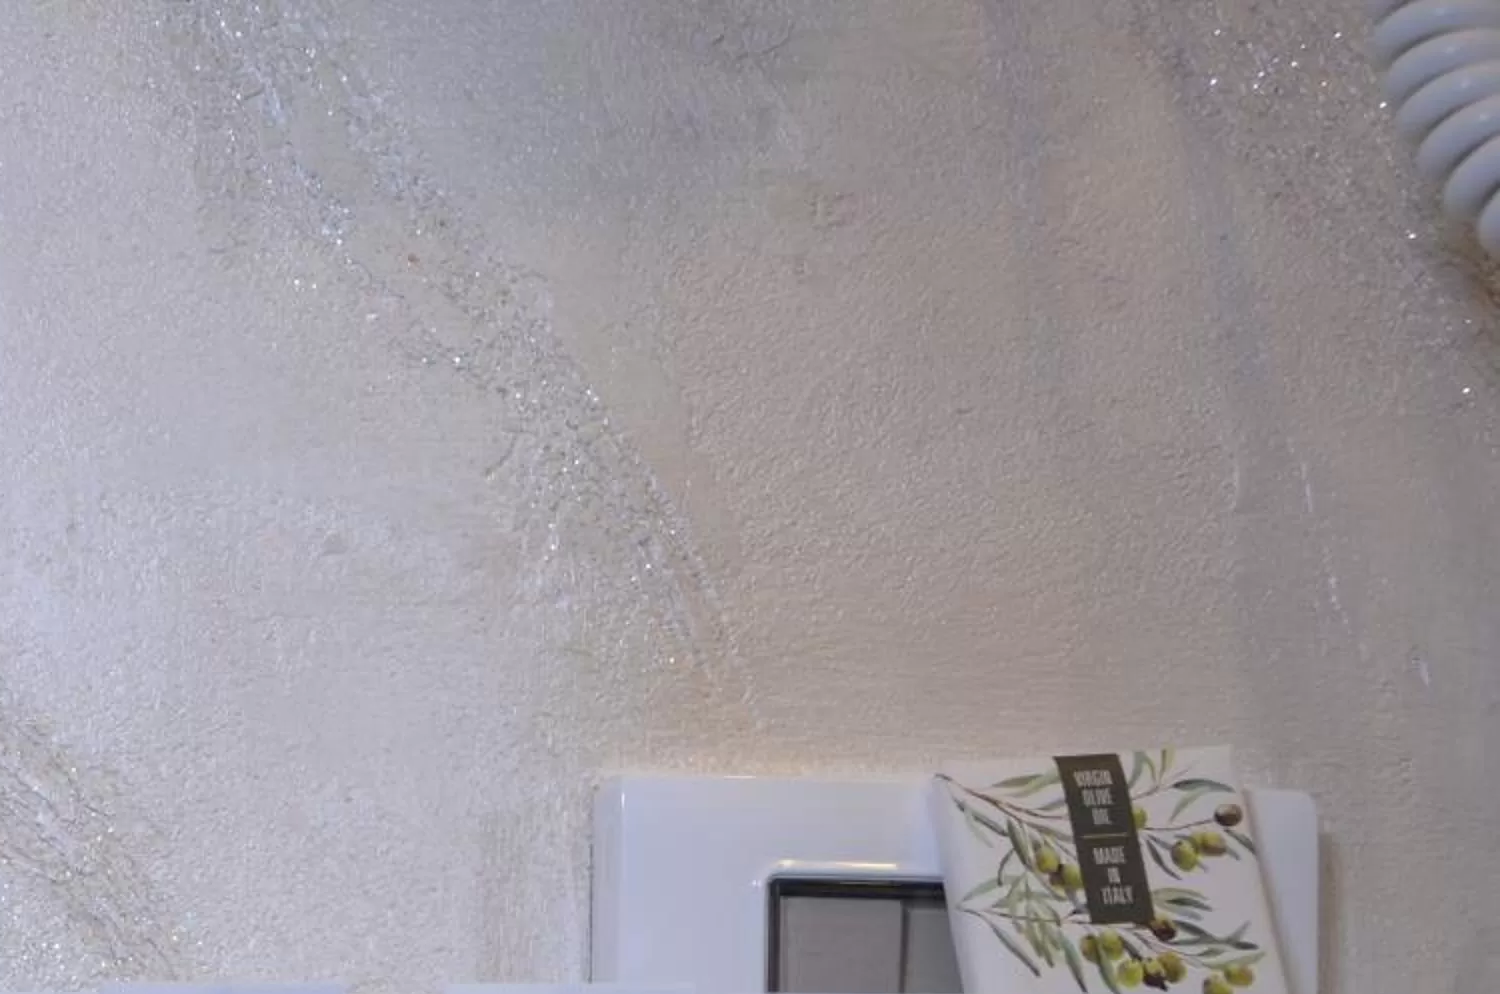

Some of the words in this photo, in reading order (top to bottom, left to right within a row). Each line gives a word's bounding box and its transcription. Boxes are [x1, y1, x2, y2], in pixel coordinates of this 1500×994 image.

[1073, 769, 1113, 787] VIRGIN
[1081, 787, 1113, 807] OLIVE
[1092, 846, 1126, 865] MADE
[1107, 867, 1121, 884] IN
[1101, 885, 1134, 905] ITALY
